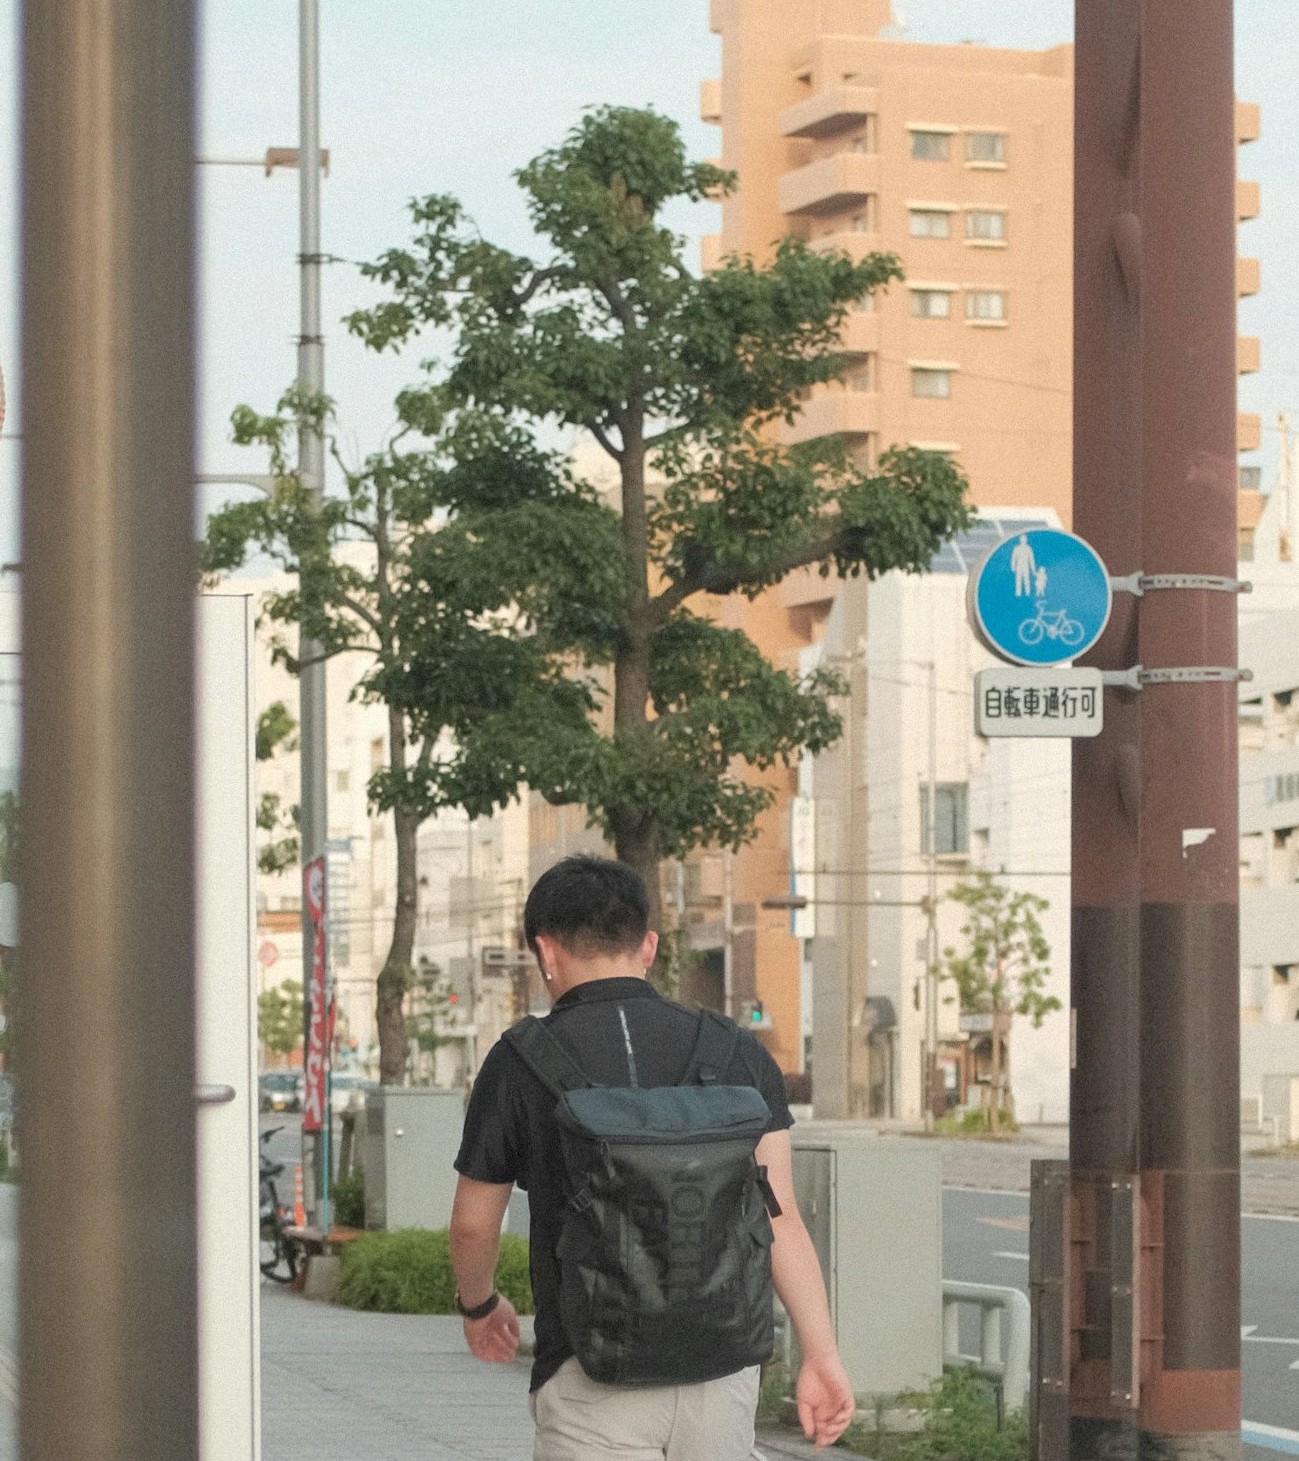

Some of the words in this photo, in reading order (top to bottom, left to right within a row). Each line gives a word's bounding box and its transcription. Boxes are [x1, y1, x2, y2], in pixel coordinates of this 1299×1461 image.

[985, 685, 1097, 718] 自転車通行可
